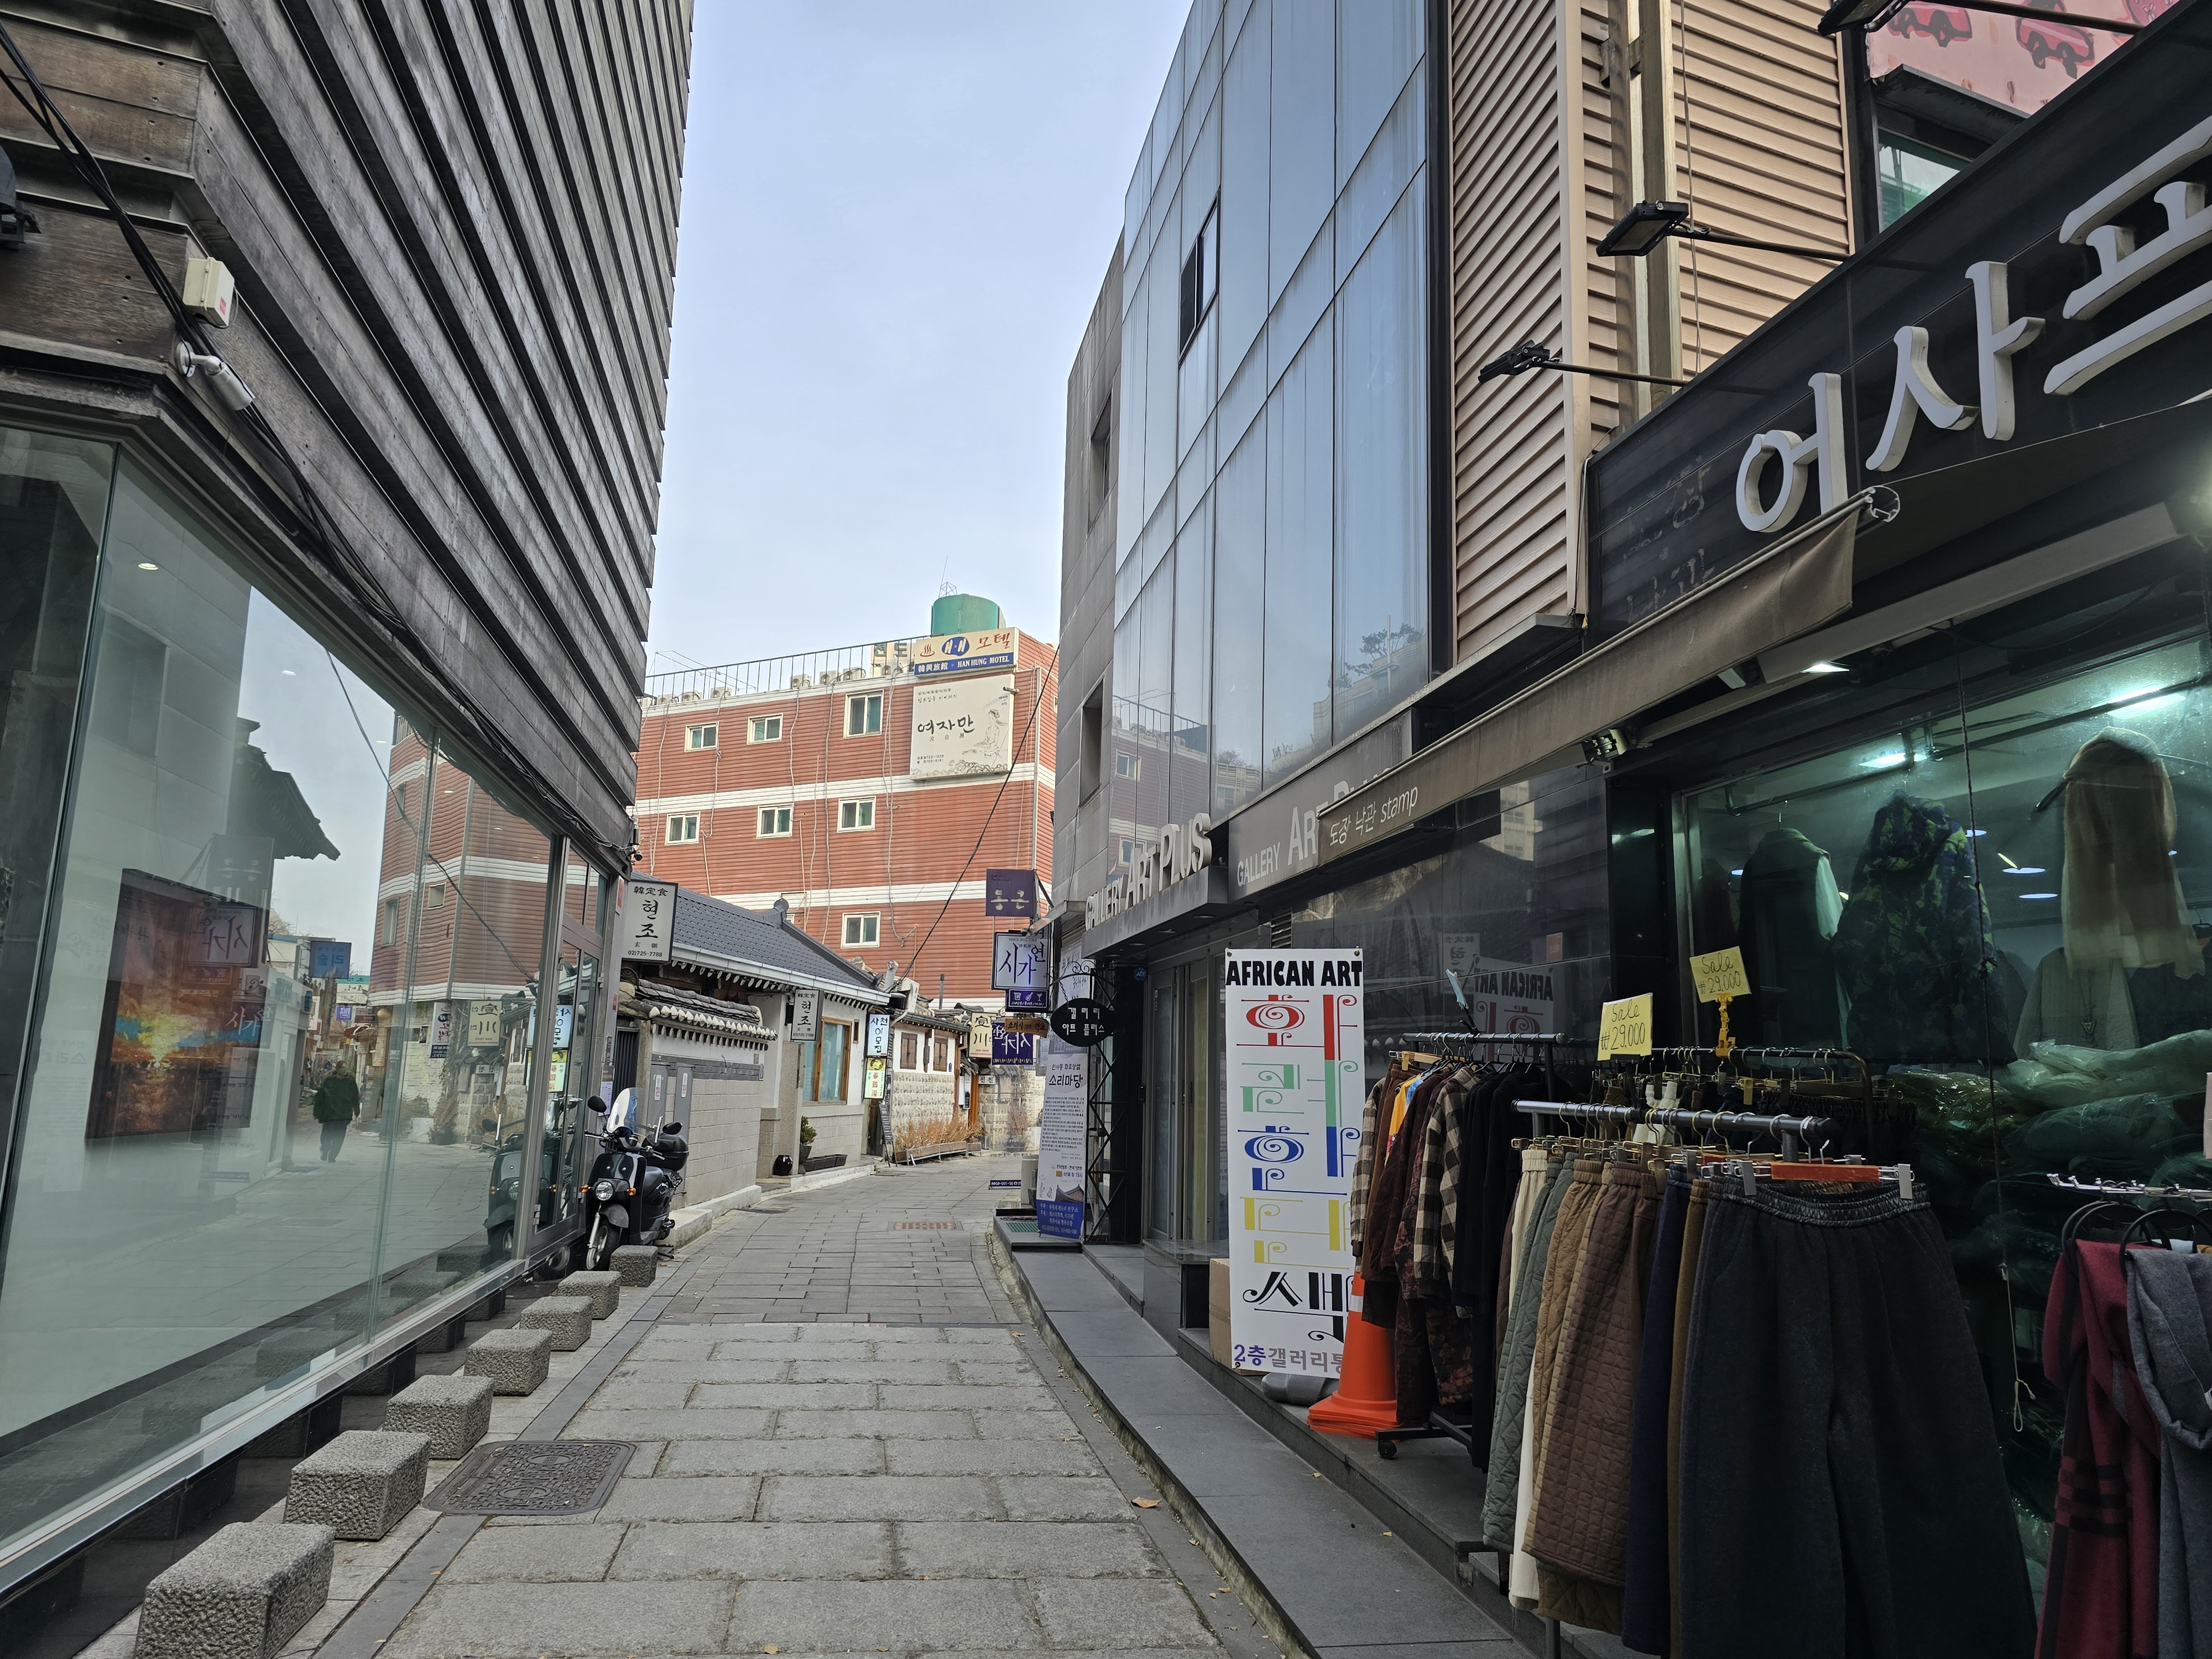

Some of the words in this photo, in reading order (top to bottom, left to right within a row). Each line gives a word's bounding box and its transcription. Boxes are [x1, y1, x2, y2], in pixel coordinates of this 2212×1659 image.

[976, 633, 1010, 650] 모텔
[971, 658, 987, 666] HUNG
[989, 655, 1009, 664] MOTEL
[917, 714, 975, 734] 여자만
[1329, 815, 1351, 846] 도장
[1355, 801, 1377, 836] 낙관
[1380, 786, 1418, 823] stamp
[1085, 874, 1125, 931] GALLERY
[1125, 844, 1160, 910] ART
[1159, 812, 1212, 892] PLUS
[1237, 842, 1281, 887] GALLERY
[633, 886, 669, 896] 韓定食
[990, 889, 1029, 911] 통큰
[635, 899, 659, 938] 현조
[998, 941, 1046, 985] 시가연
[1225, 960, 1314, 987] AFRICAN
[1321, 960, 1363, 987] ART
[1702, 952, 1734, 974] Sale
[797, 1000, 811, 1026] 현조
[1068, 1007, 1100, 1020] 갤러리
[1611, 999, 1640, 1022] Sale
[870, 1018, 888, 1026] 사천
[1062, 1024, 1076, 1036] 아트
[1083, 1024, 1105, 1036] 플러스
[874, 1027, 883, 1053] 이모집
[1048, 1074, 1083, 1088] 소리마당
[1234, 1344, 1266, 1366] 2층
